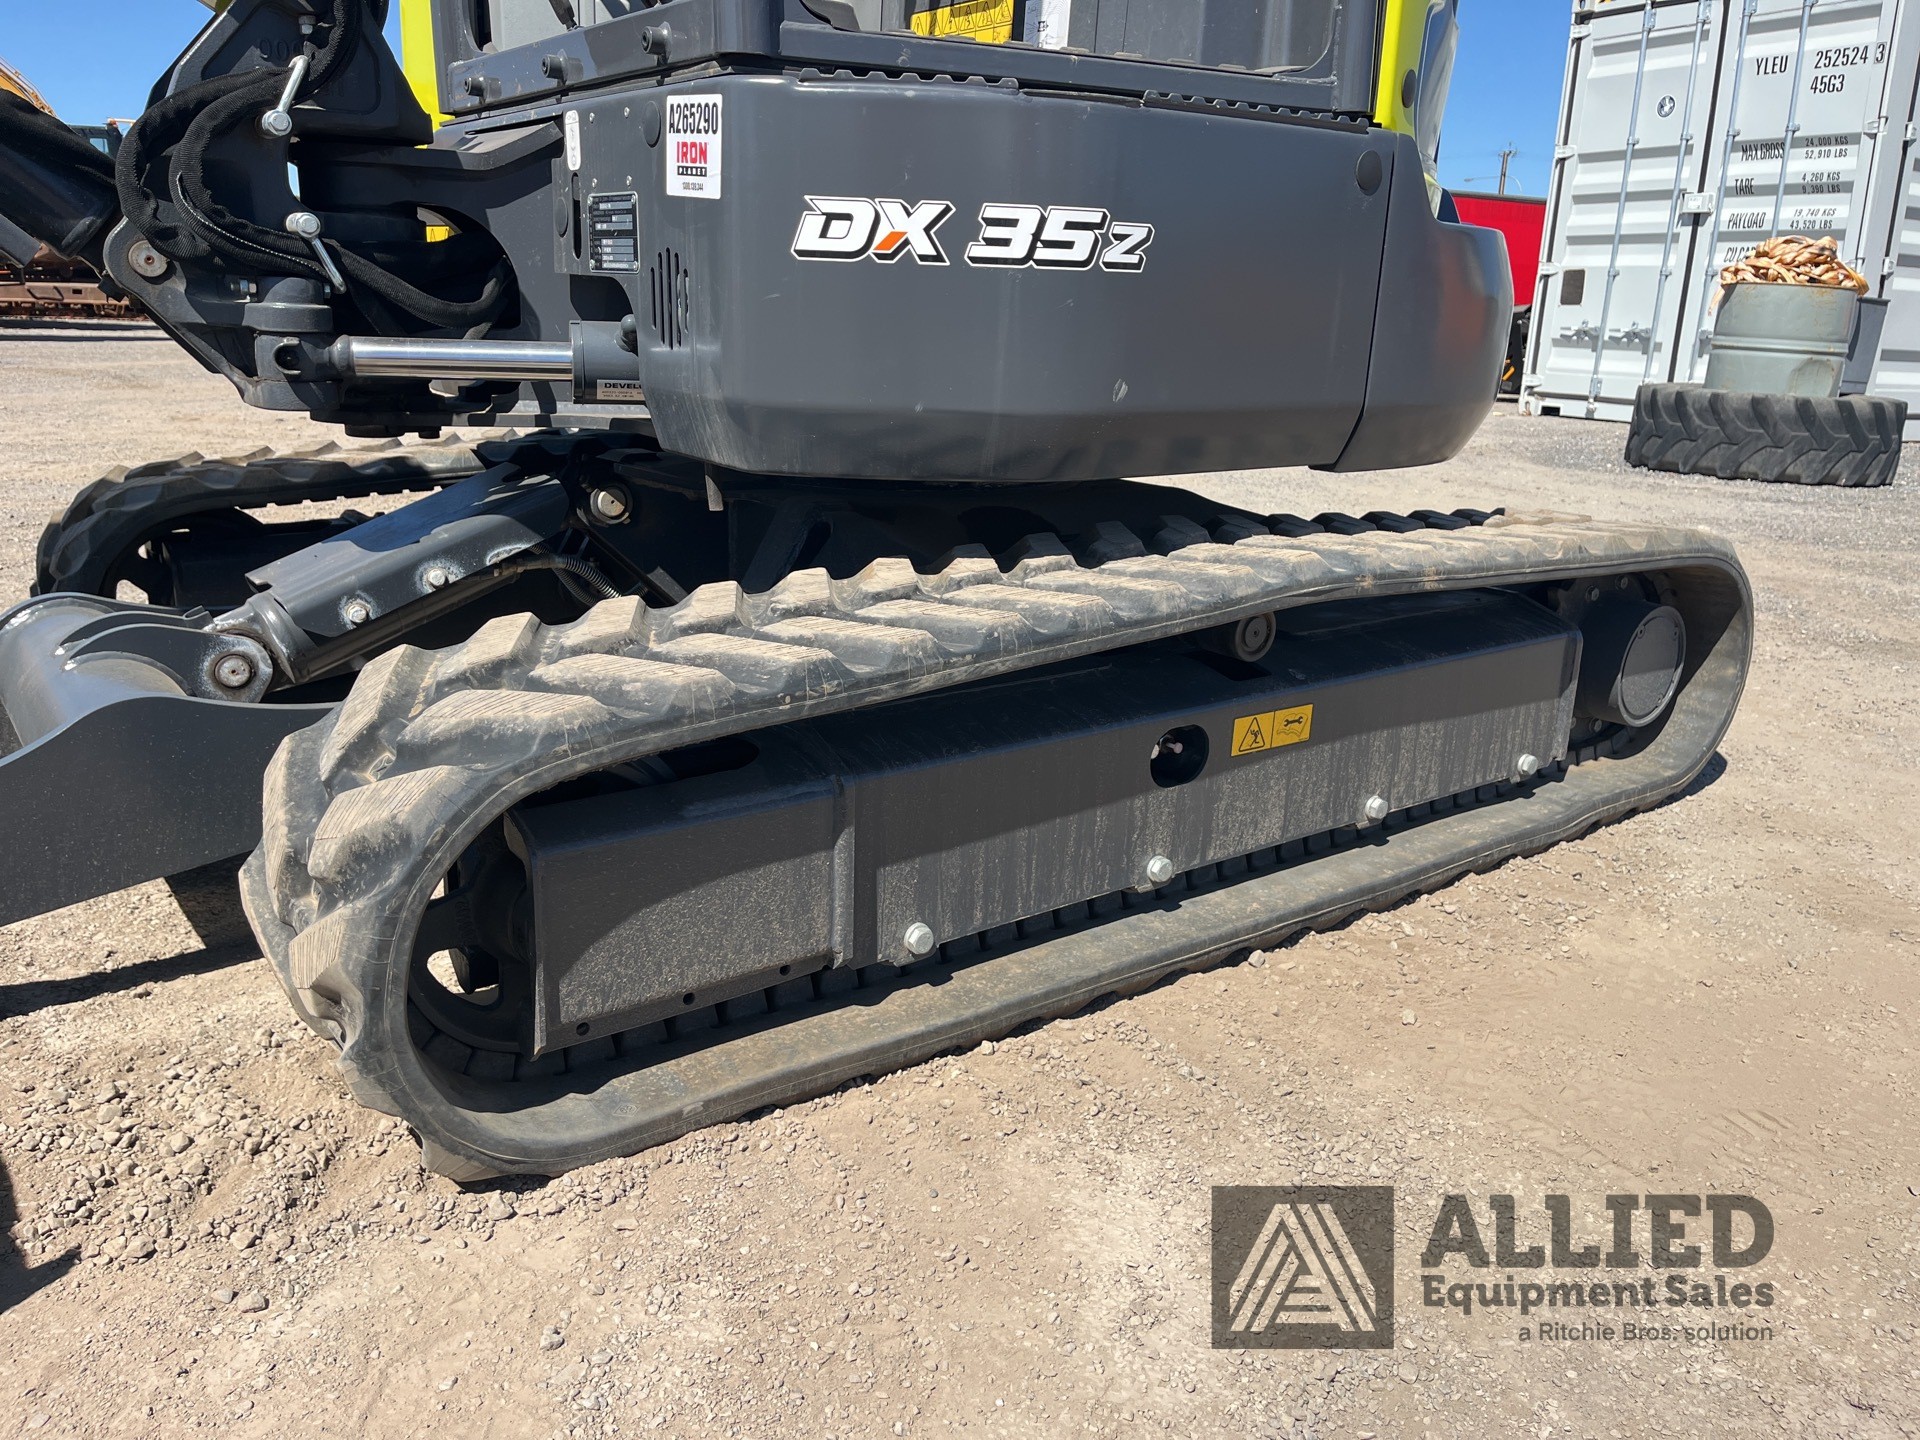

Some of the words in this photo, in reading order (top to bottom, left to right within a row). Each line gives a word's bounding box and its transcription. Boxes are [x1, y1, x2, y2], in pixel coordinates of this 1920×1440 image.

[1756, 55, 1789, 76] YLEU
[1814, 45, 1869, 69] 252524
[1875, 43, 1886, 63] 3
[1810, 74, 1845, 94] 45G3
[668, 102, 719, 135] A265290
[1835, 136, 1849, 145] KGS
[676, 141, 708, 165] IRON
[1834, 148, 1848, 158] LBS
[678, 167, 706, 176] PLANET
[1735, 178, 1755, 195] TARE
[1827, 172, 1841, 181] KGS
[1827, 184, 1841, 193] LBS
[1727, 212, 1766, 230] PAYLOAD
[1822, 208, 1837, 217] KGS
[1819, 220, 1833, 229] LBS
[791, 195, 956, 266] DX
